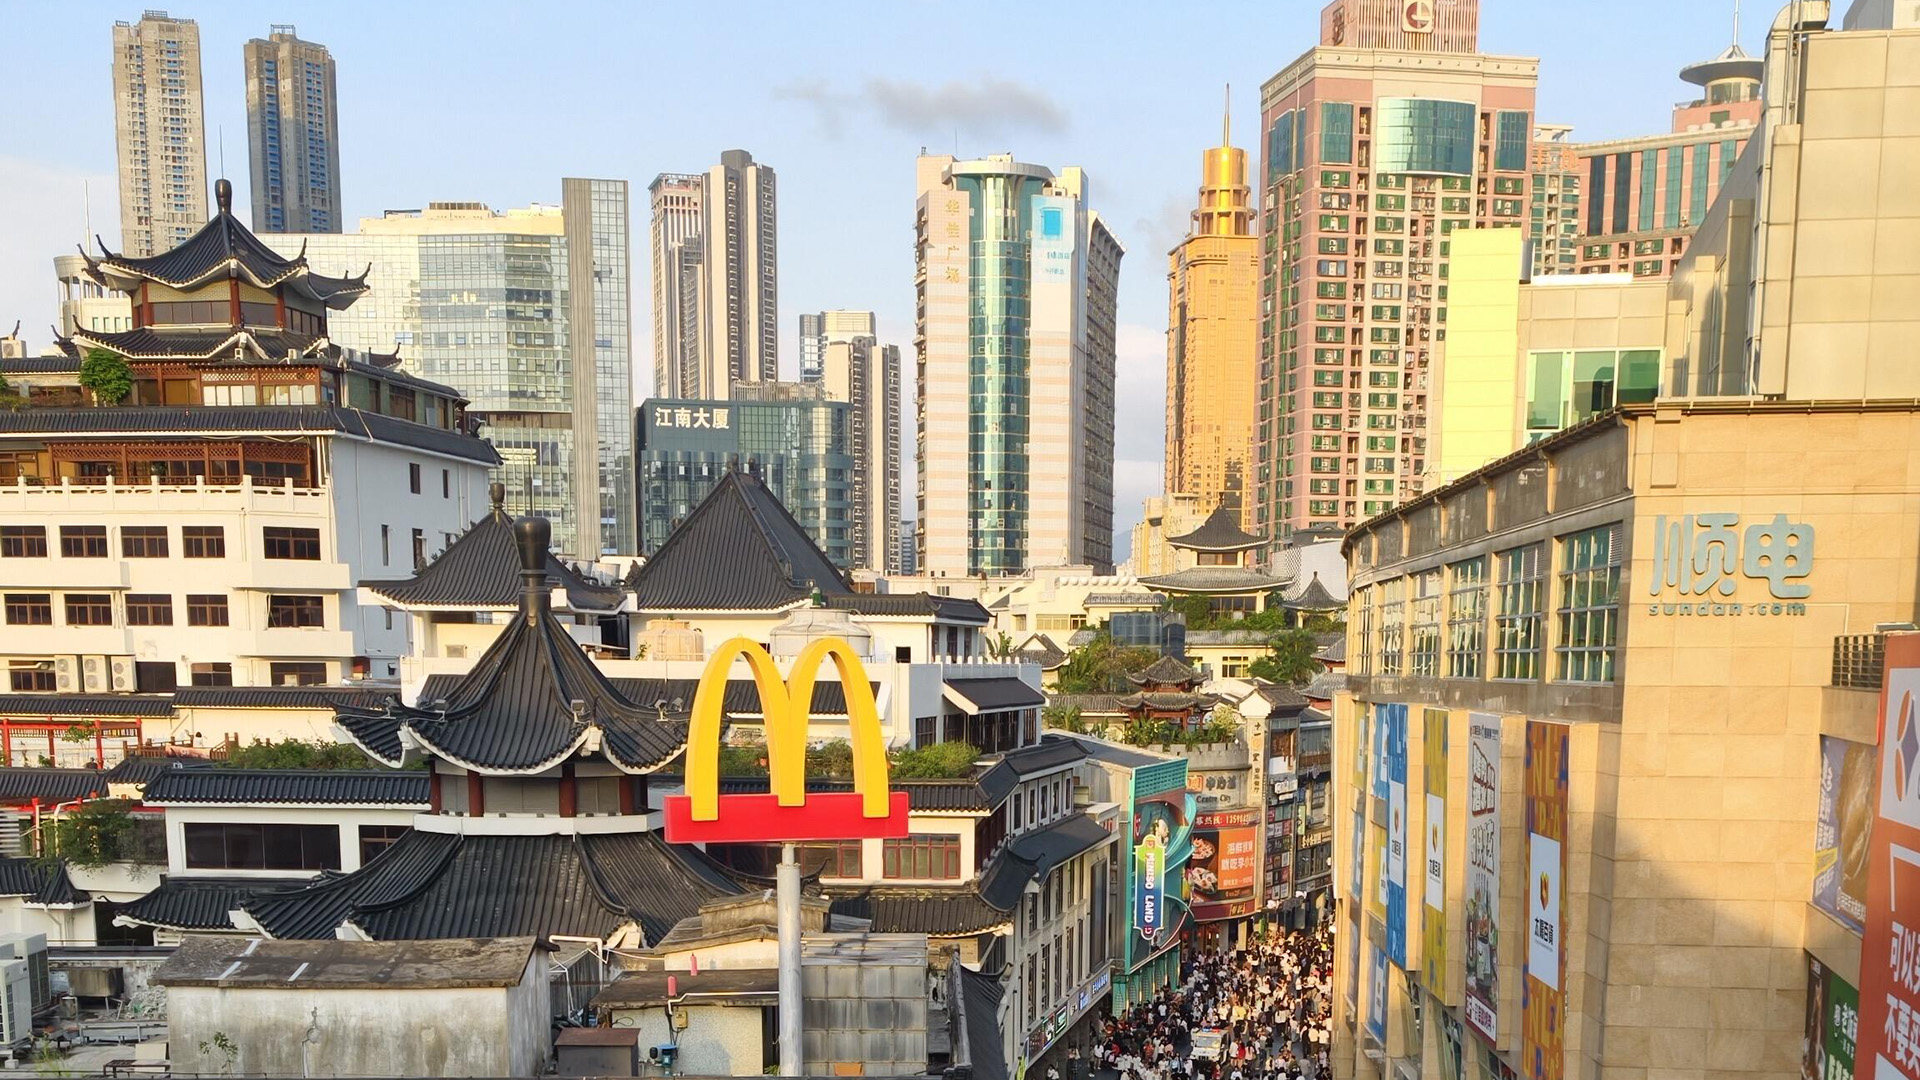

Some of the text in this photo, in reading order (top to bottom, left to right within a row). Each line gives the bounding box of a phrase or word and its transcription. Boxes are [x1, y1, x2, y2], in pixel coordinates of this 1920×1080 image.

[655, 407, 729, 429] 江南大厦
[1650, 513, 1815, 599] 顺电
[1649, 602, 1806, 616] sundan.com
[1144, 852, 1155, 924] MINISO LAND
